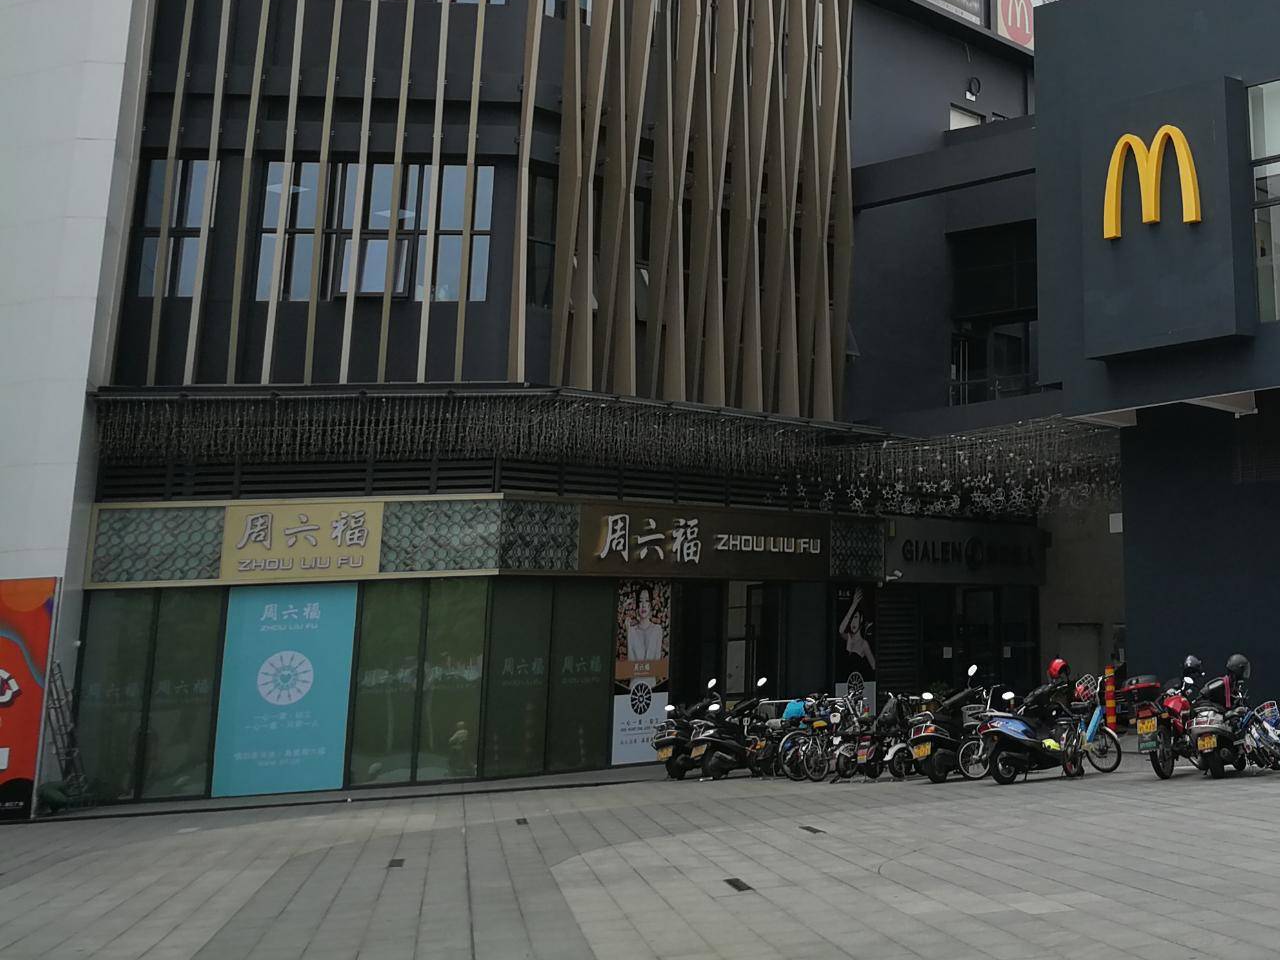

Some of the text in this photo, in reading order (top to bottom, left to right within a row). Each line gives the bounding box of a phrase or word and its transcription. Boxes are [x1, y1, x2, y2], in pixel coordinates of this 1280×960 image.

[235, 510, 369, 550] 周六福
[600, 513, 702, 564] 周六福
[716, 533, 821, 554] ZHOU LIU FU
[237, 555, 364, 571] ZHOU LIU FU
